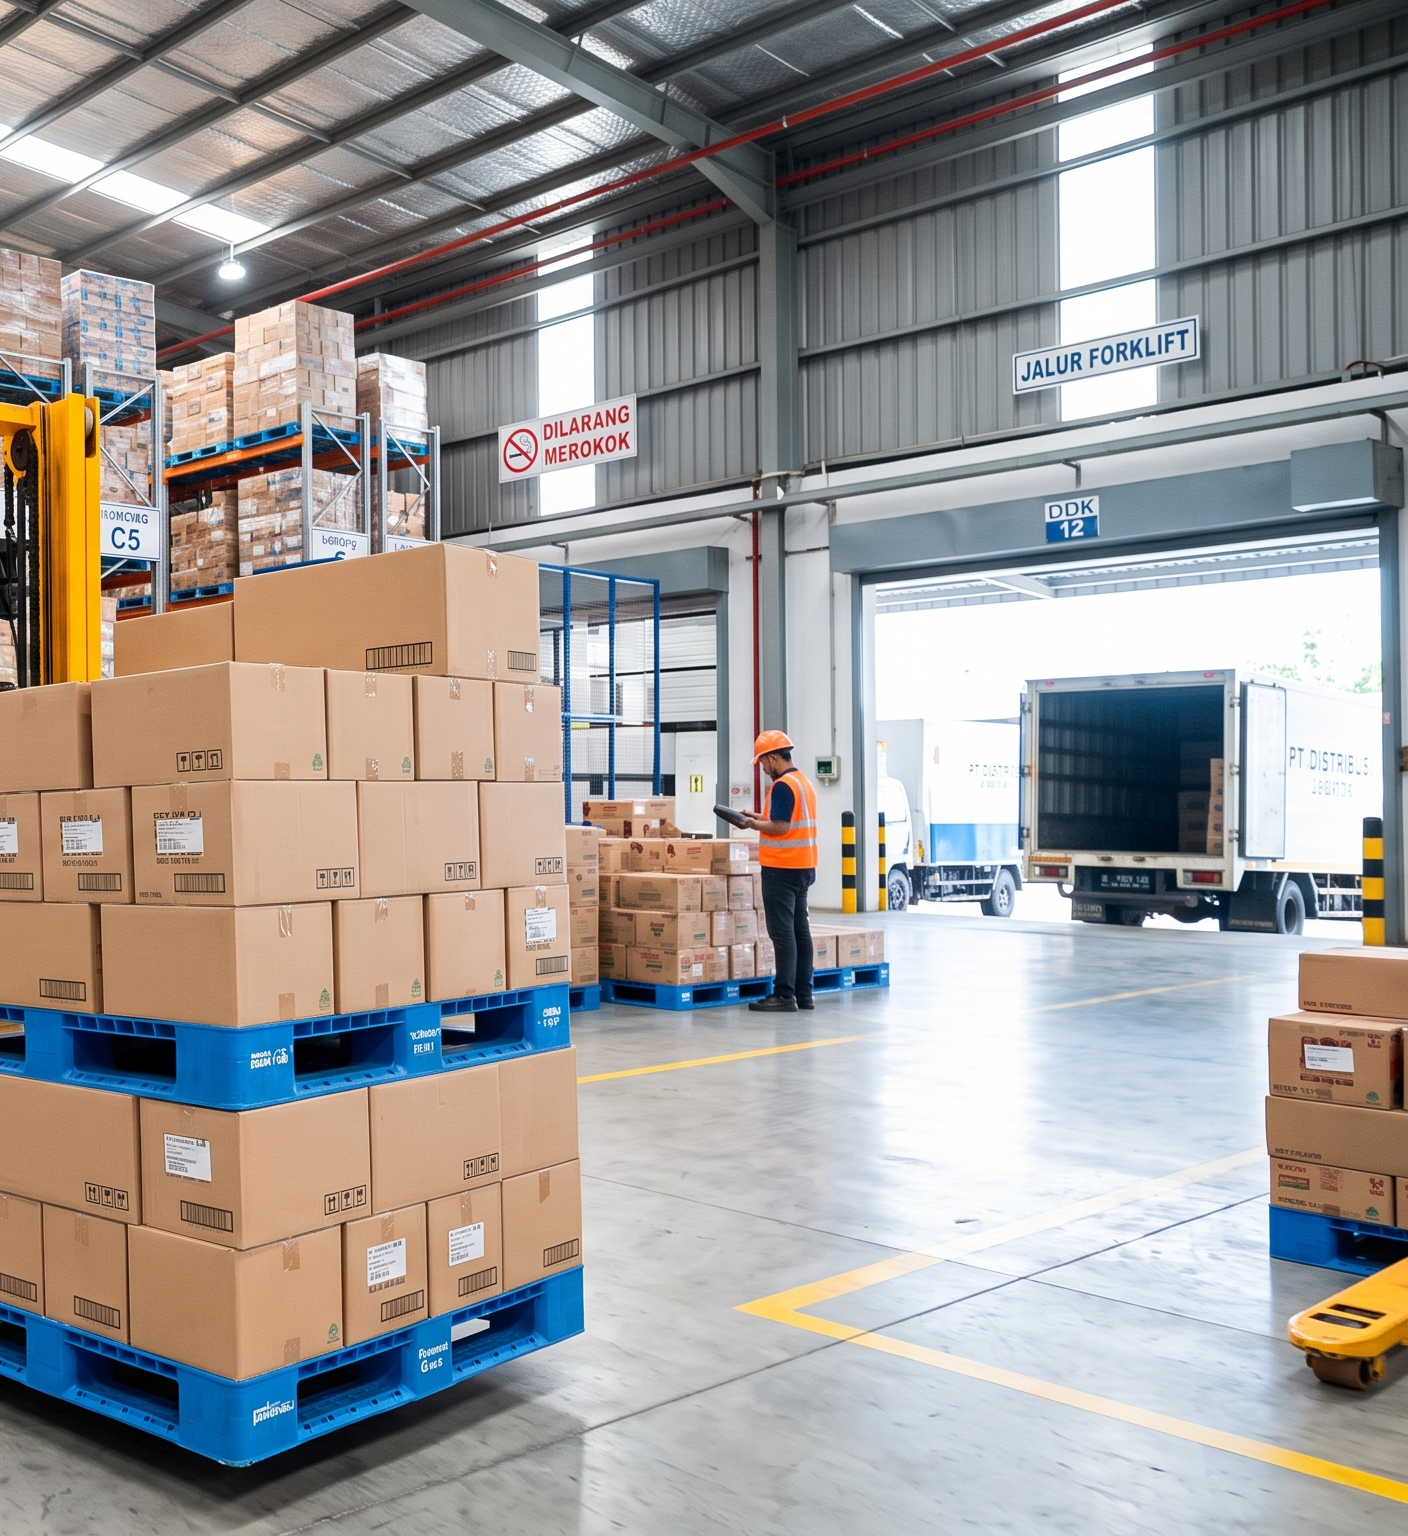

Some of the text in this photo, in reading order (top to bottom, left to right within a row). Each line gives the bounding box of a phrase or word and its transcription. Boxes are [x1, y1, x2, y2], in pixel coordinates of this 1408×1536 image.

[1021, 328, 1189, 382] JALUR FORKLIFT
[543, 405, 630, 441] DILARANG
[544, 431, 631, 466] MEROKOK
[1049, 498, 1095, 519] DDK
[111, 526, 141, 551] C5
[1059, 519, 1084, 538] 12
[1289, 746, 1373, 776] PT DISTRIBUS
